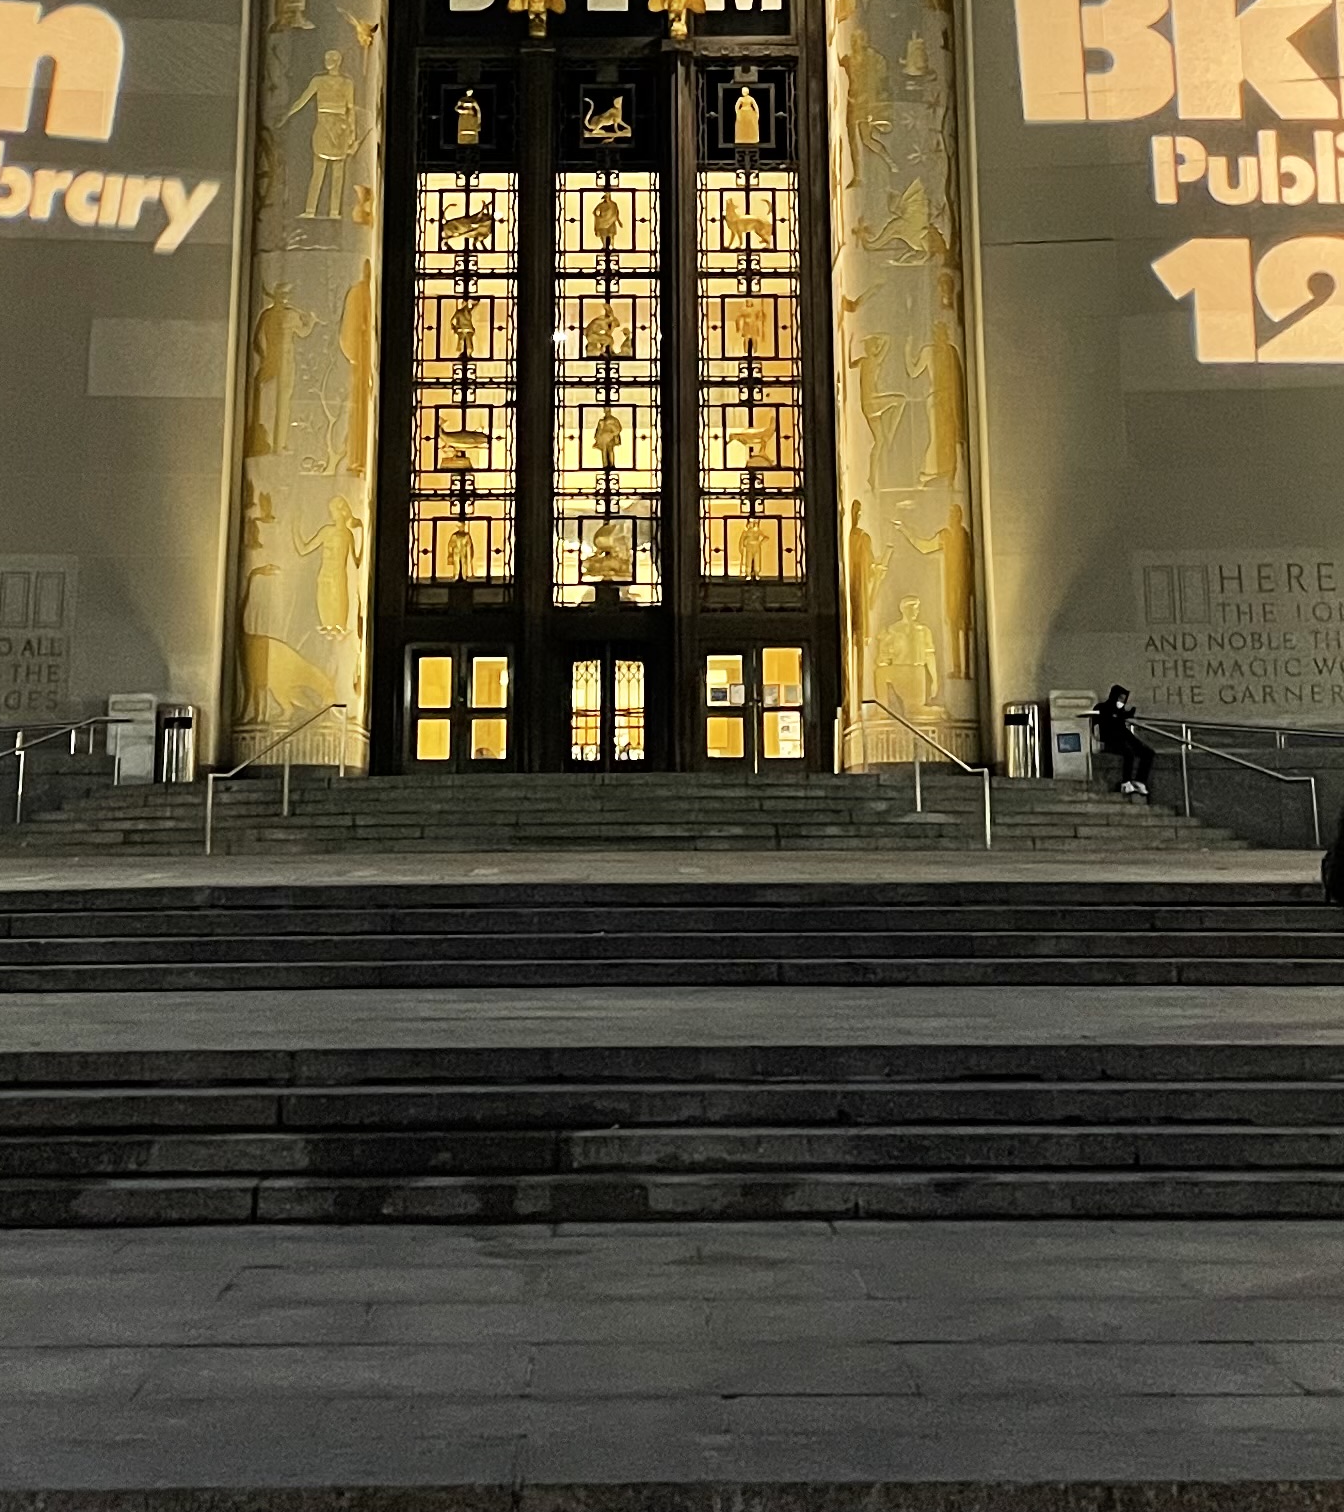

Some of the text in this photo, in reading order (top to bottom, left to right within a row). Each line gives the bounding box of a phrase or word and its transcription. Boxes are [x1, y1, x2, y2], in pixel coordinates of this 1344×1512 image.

[1217, 561, 1337, 594] HERE
[1216, 600, 1278, 624] THE
[20, 637, 63, 657] ALL
[1144, 632, 1198, 652] AND
[1207, 631, 1298, 652] NOBLE
[10, 663, 60, 683] THE
[1147, 658, 1195, 679] THE
[1205, 656, 1303, 678] MAGIC
[1151, 683, 1205, 706] THE
